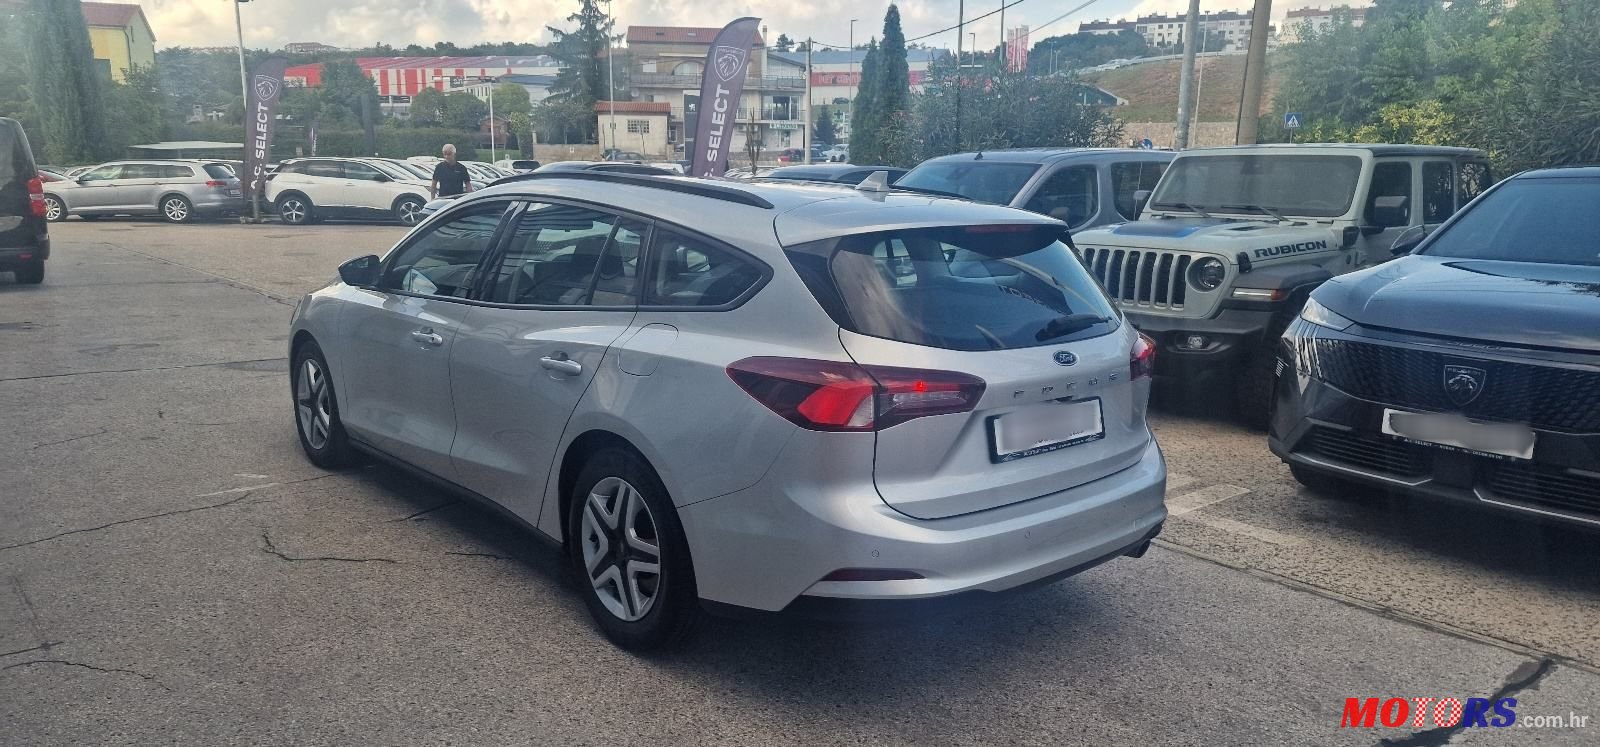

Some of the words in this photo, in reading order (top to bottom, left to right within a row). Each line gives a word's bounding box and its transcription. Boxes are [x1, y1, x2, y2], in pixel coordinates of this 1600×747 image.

[255, 102, 269, 159] SELECT
[706, 84, 730, 162] SELECT
[1254, 239, 1327, 258] RUBICON
